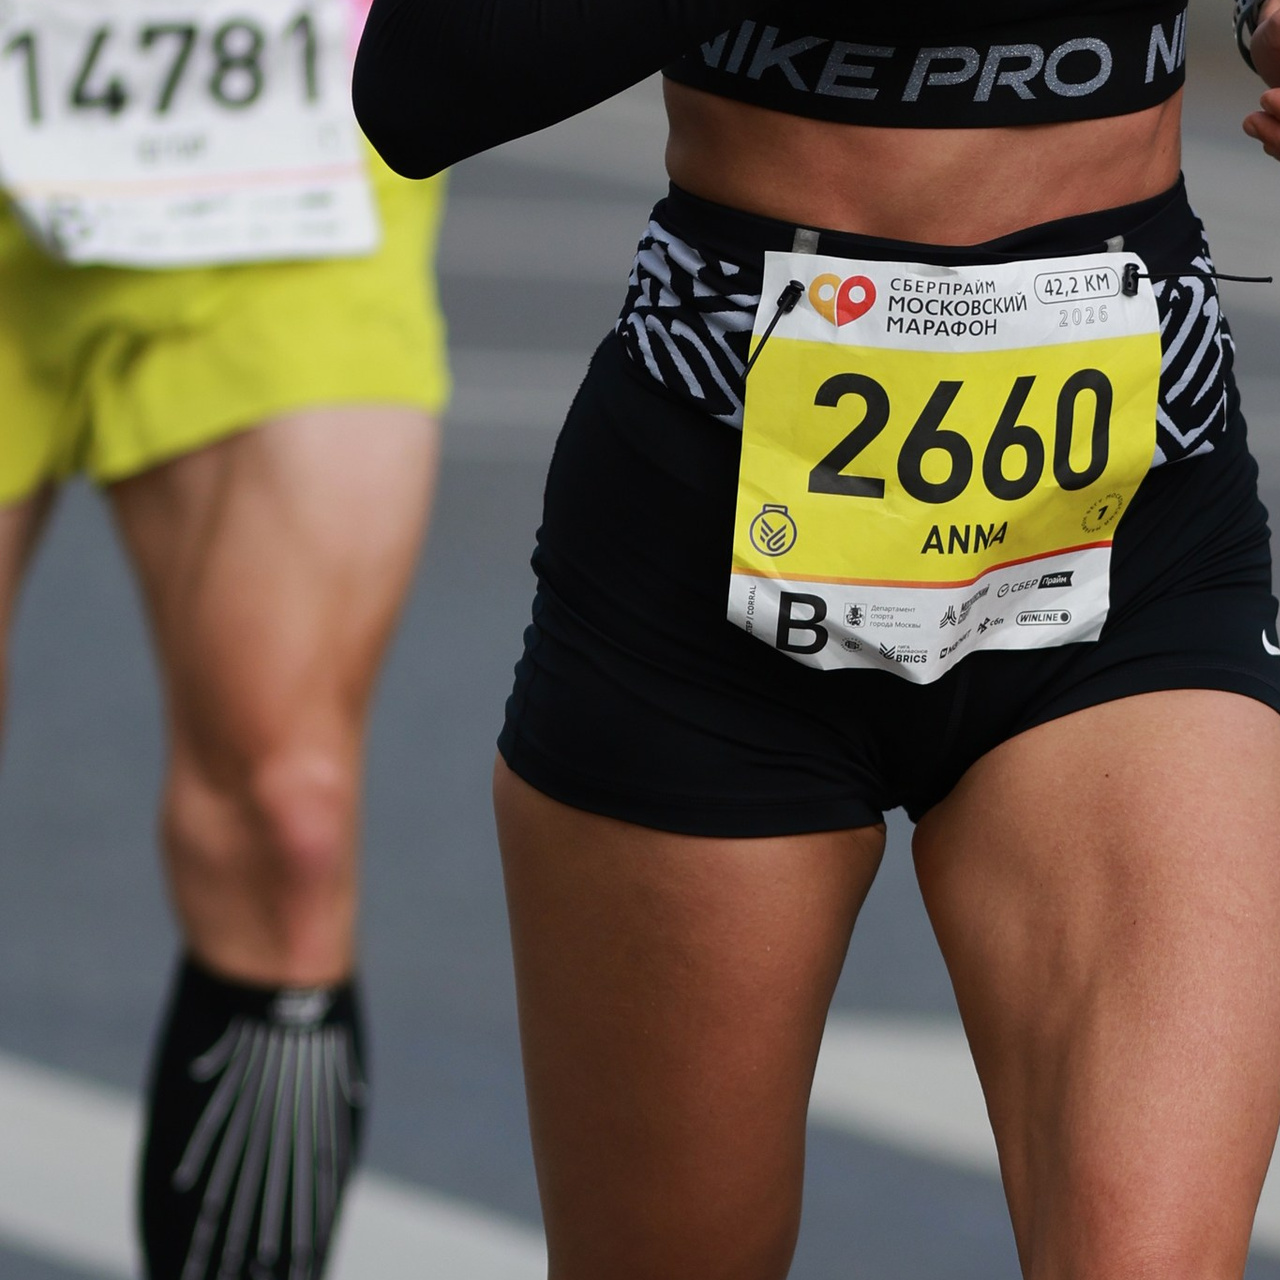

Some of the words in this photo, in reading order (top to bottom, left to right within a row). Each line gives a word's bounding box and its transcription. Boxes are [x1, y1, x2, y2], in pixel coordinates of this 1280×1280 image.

[4, 12, 319, 126] 14781
[901, 36, 1113, 102] PRO
[890, 278, 997, 296] СБЕРПРАЙМ
[1044, 276, 1079, 298] 42,2
[887, 291, 1028, 317] МОСКОВСКИЙ
[886, 317, 998, 337] МАРАФОН
[1058, 305, 1109, 328] 2026
[807, 368, 1114, 505] 2660
[921, 521, 1009, 555] ANNA
[1011, 579, 1039, 593] СБЕР
[1042, 575, 1067, 586] Прайм
[746, 585, 757, 616] CORRAL
[870, 605, 916, 613] Департамент
[776, 591, 829, 655] B
[1020, 613, 1059, 622] WINLINE
[895, 654, 928, 664] BRICS
